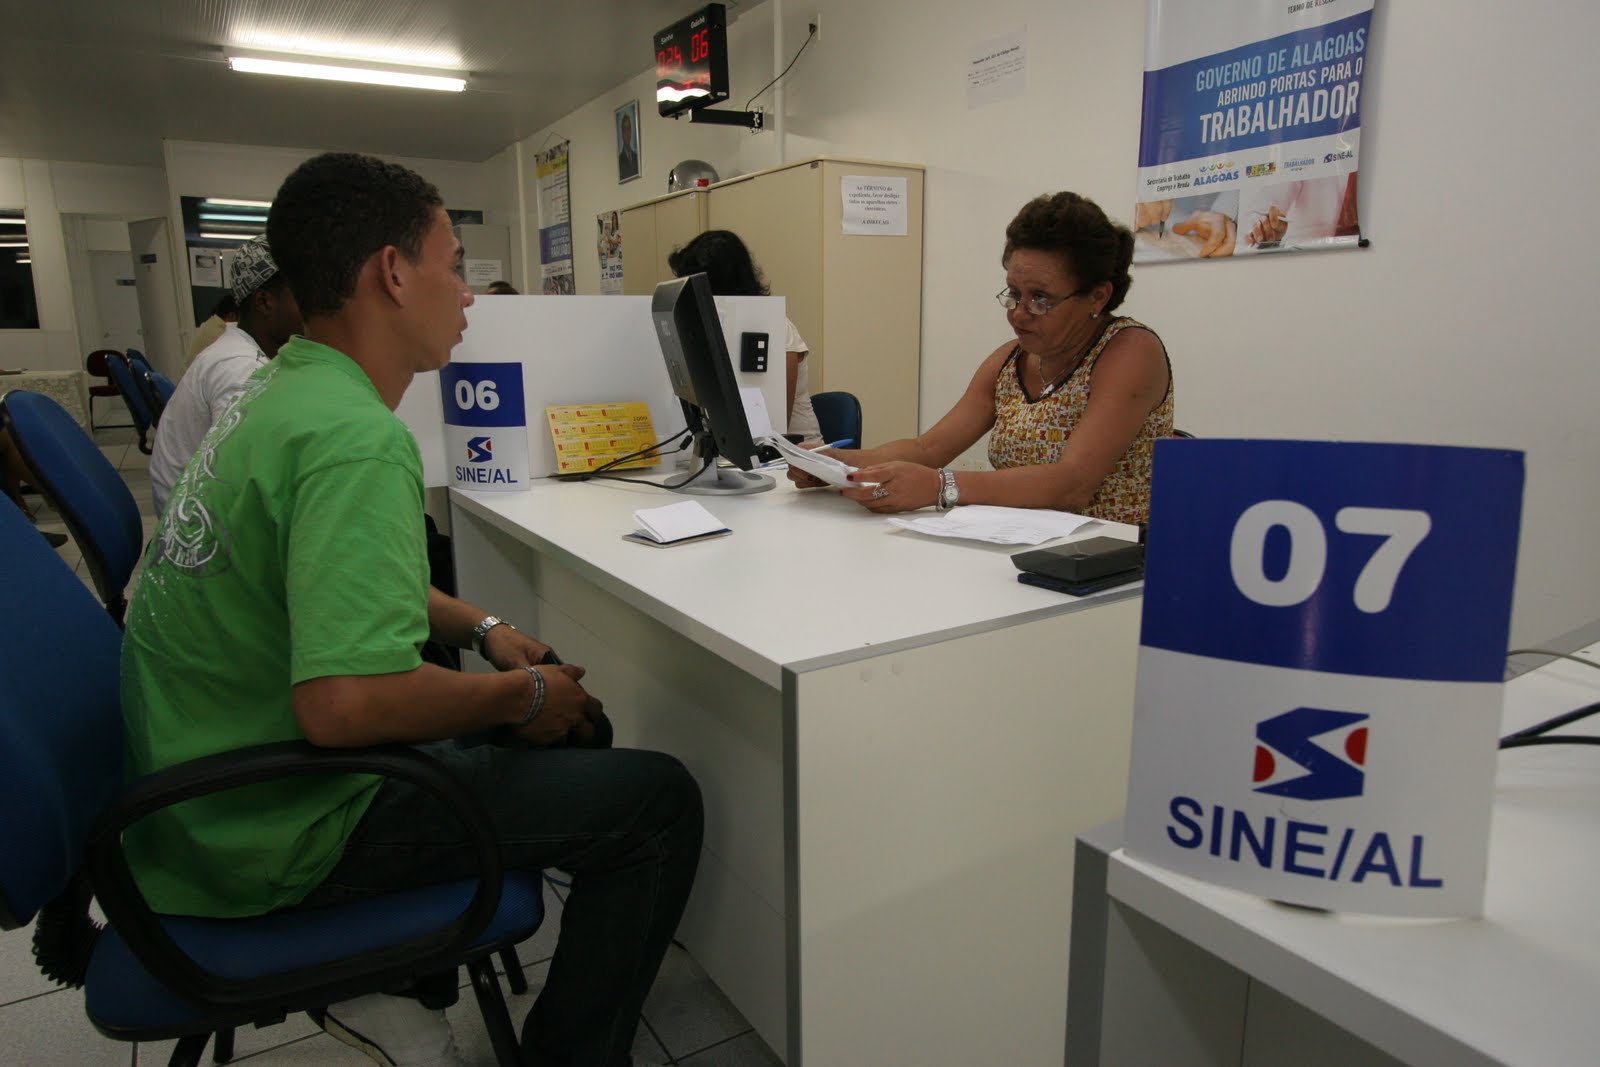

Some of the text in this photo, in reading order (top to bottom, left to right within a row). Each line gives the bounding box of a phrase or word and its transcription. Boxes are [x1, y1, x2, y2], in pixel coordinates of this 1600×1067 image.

[1288, 3, 1304, 14] TERMO
[1306, 1, 1313, 9] DE
[691, 29, 709, 62] 06
[1196, 28, 1366, 92] GOVERNO DE ALAGOAS
[1217, 57, 1363, 107] ABRINDO PORTAS PARA O
[1200, 82, 1360, 143] TRABALHADOR
[1193, 171, 1239, 186] ALAGOAS
[1284, 158, 1315, 168] TRABALHADOR
[455, 379, 500, 411] 06
[456, 465, 518, 484] SINE/AL
[1229, 499, 1432, 614] 07
[1166, 795, 1443, 888] SINE/AL
